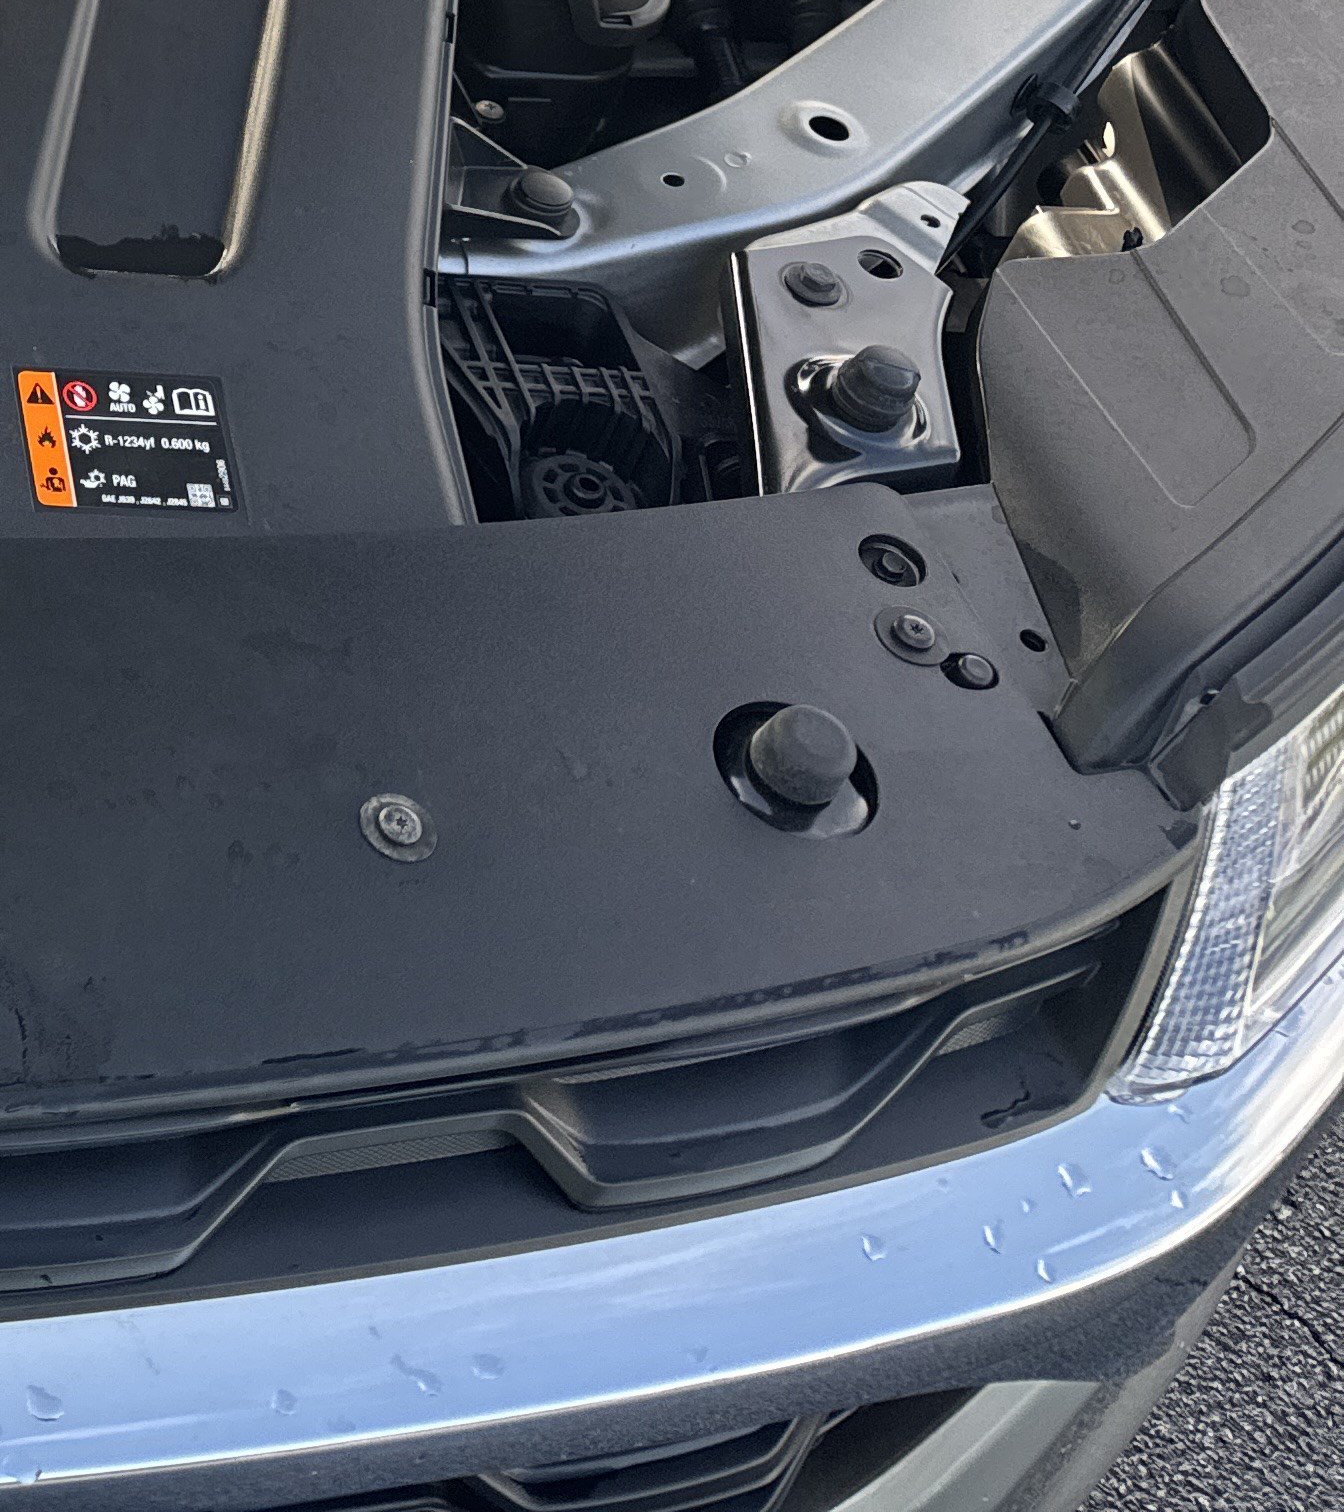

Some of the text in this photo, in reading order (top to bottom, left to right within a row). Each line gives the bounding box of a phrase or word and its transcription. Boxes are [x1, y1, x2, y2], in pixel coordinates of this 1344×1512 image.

[109, 402, 136, 413] AUTO
[104, 434, 210, 453] R-1234yf 0.600 kg
[112, 474, 137, 488] PAG
